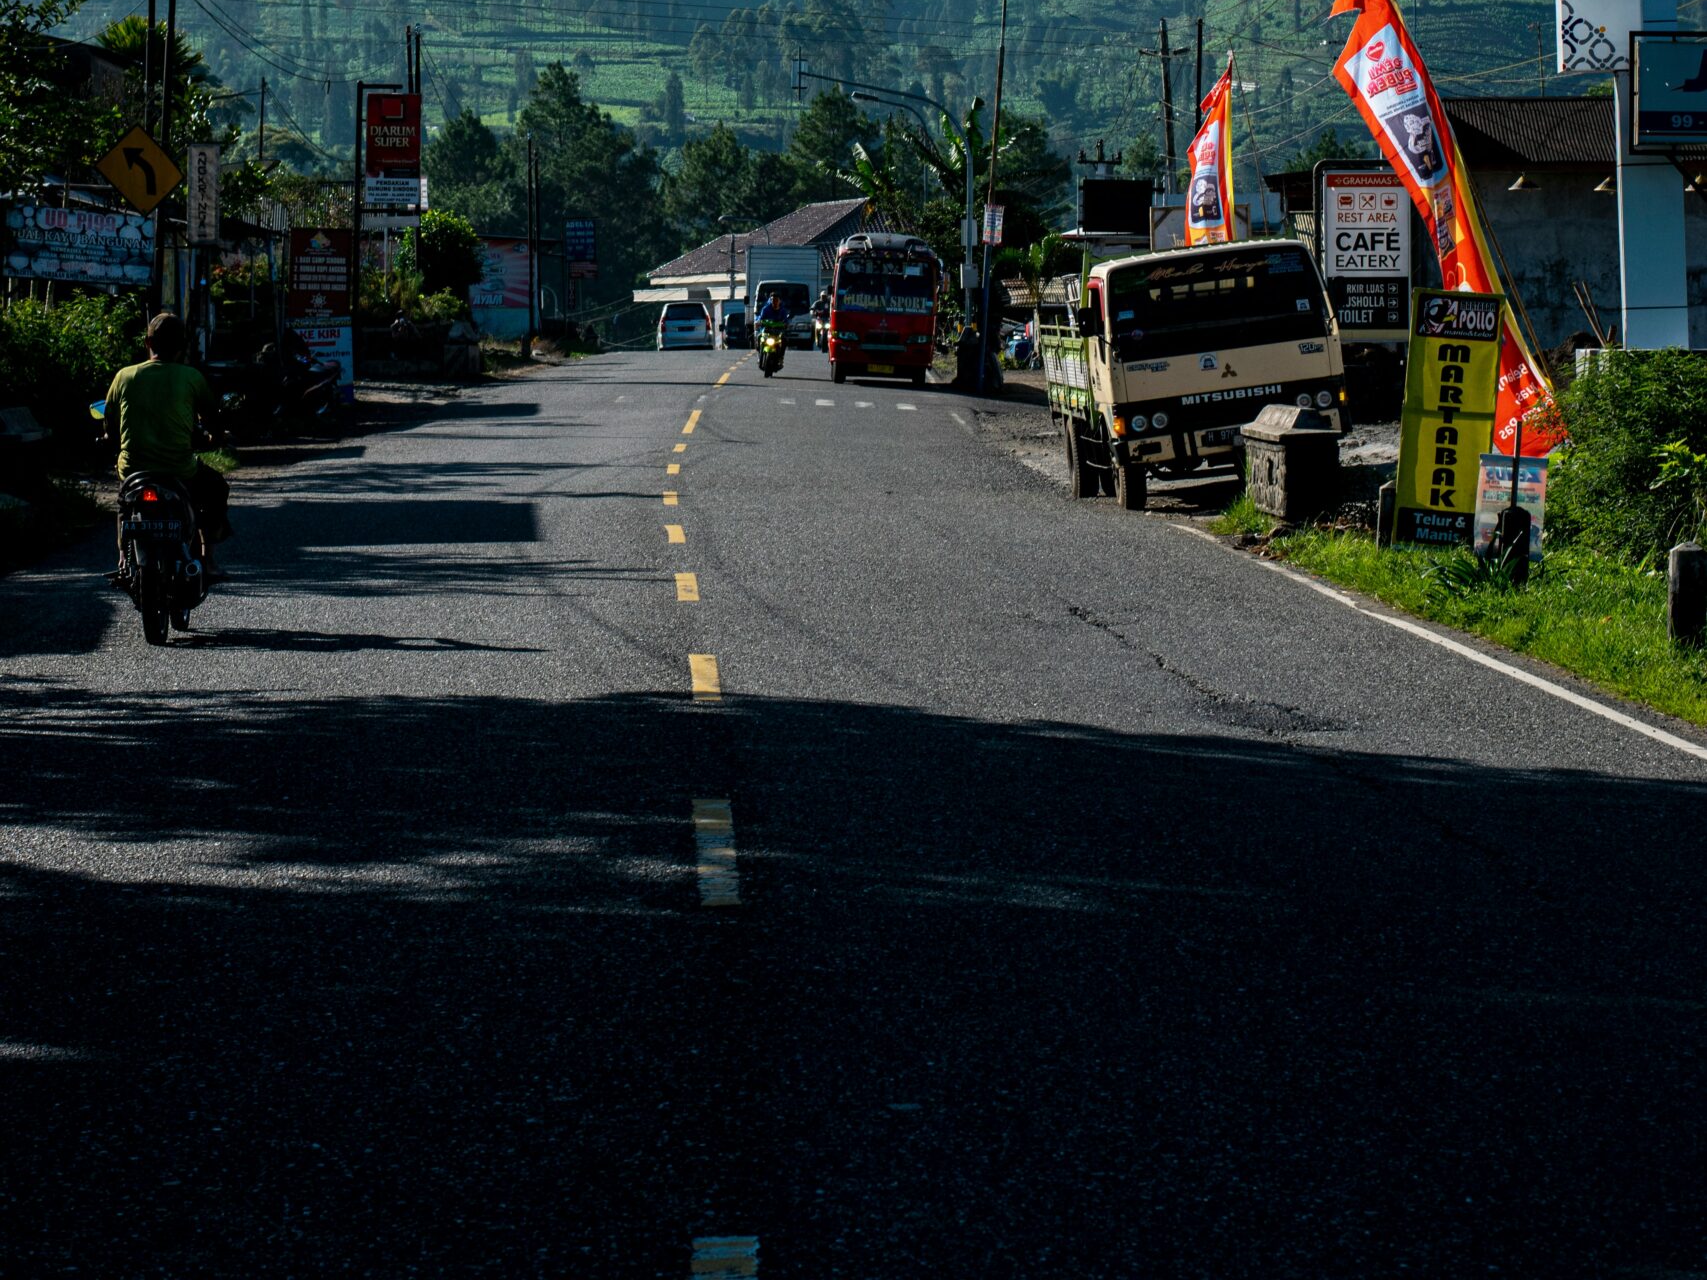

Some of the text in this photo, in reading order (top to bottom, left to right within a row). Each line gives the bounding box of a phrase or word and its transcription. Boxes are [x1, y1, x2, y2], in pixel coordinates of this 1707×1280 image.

[1671, 113, 1694, 128] 99
[370, 125, 415, 137] DJARUM
[374, 136, 410, 147] SUPER
[1342, 176, 1393, 185] GRAHAMAS
[1338, 212, 1397, 223] REST AREA
[44, 231, 79, 244] KAYU
[82, 235, 151, 249] BANGUNAN
[1336, 228, 1400, 251] CAFÉ
[1336, 255, 1400, 267] EATERY
[1346, 284, 1385, 294] RKIR LUAS
[473, 294, 504, 305] AYAM
[1338, 310, 1374, 324] TOILET
[318, 328, 341, 339] KIRI
[1181, 384, 1282, 405] MITSUBISHI
[1429, 344, 1471, 508] MARTABAK
[1413, 511, 1466, 529] Telur &
[1416, 527, 1460, 542] Manis
